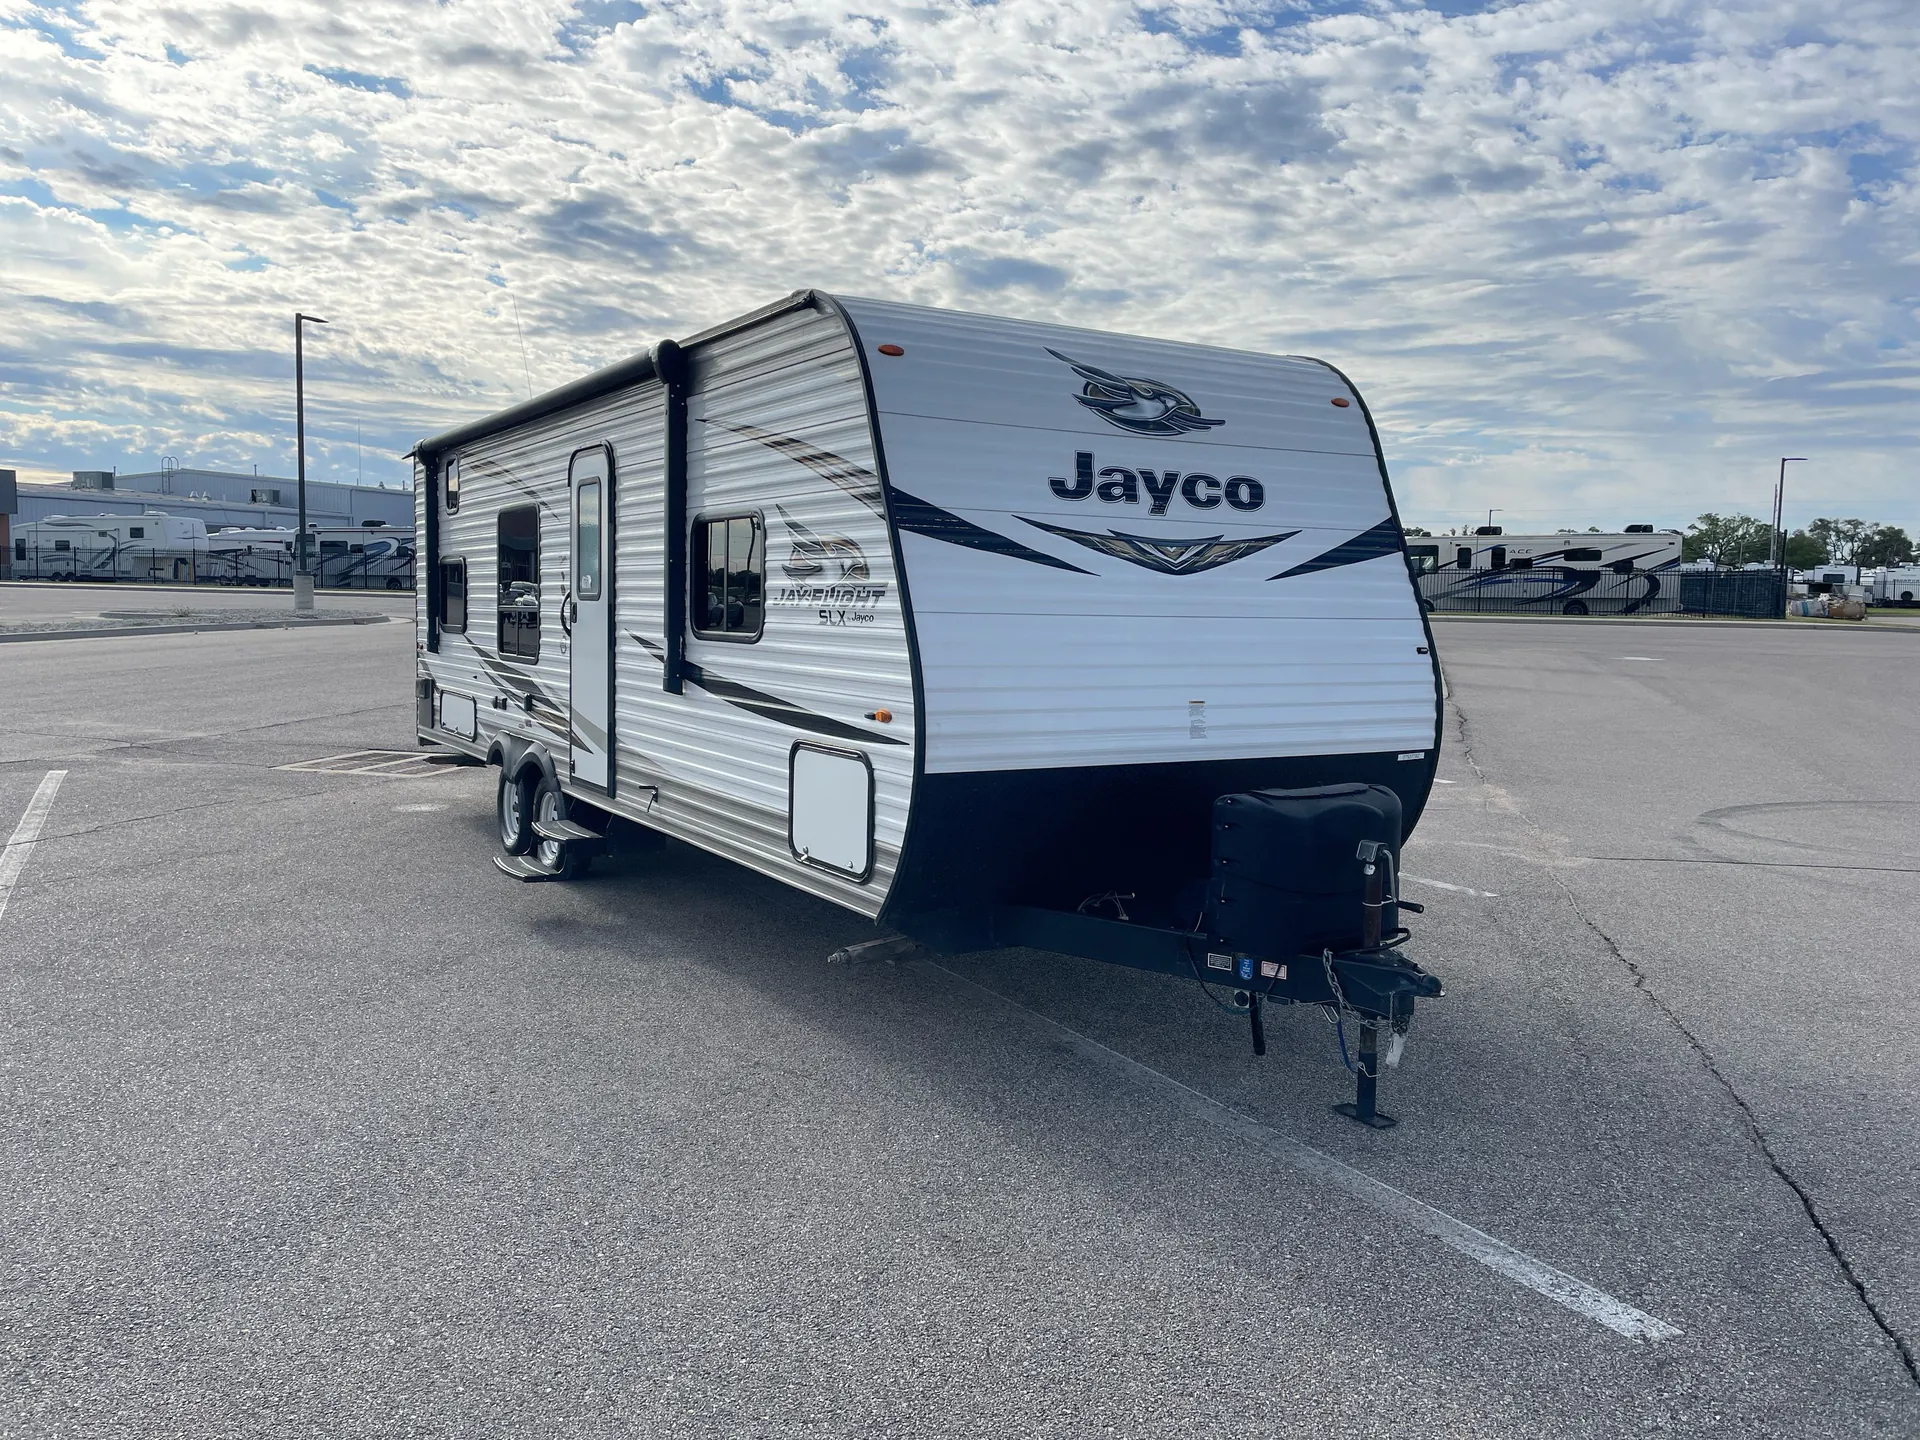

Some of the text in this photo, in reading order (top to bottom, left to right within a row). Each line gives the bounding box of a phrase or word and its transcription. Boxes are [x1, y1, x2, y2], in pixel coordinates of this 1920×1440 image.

[1048, 450, 1265, 516] Jayco
[818, 610, 875, 626] SLX Jayco
